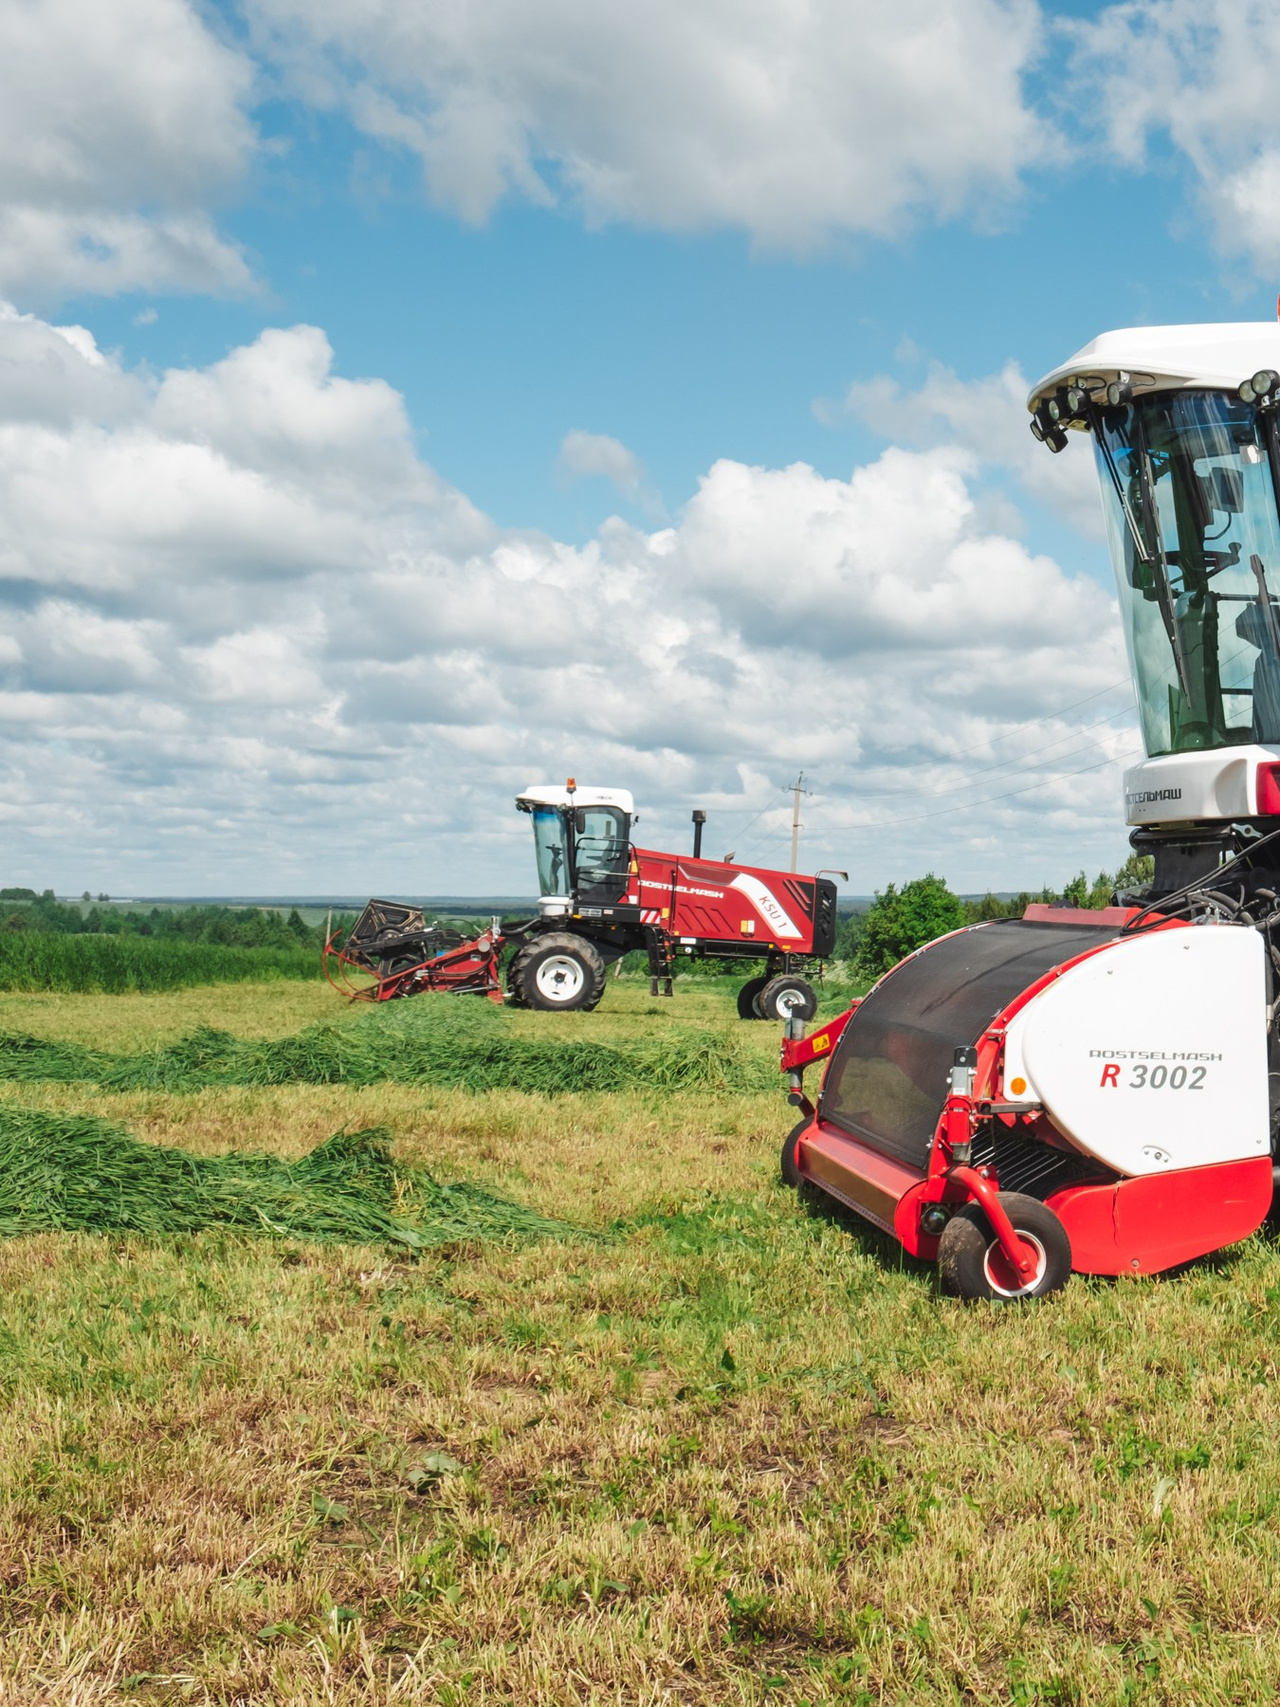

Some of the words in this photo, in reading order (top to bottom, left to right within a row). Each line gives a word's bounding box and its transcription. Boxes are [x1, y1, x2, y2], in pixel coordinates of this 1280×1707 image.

[637, 880, 724, 898] ROSTSELMASH
[759, 896, 781, 919] KSU
[1089, 1049, 1223, 1062] ROSTSELMASH
[1100, 1063, 1121, 1088] R
[1129, 1064, 1208, 1090] 3002
